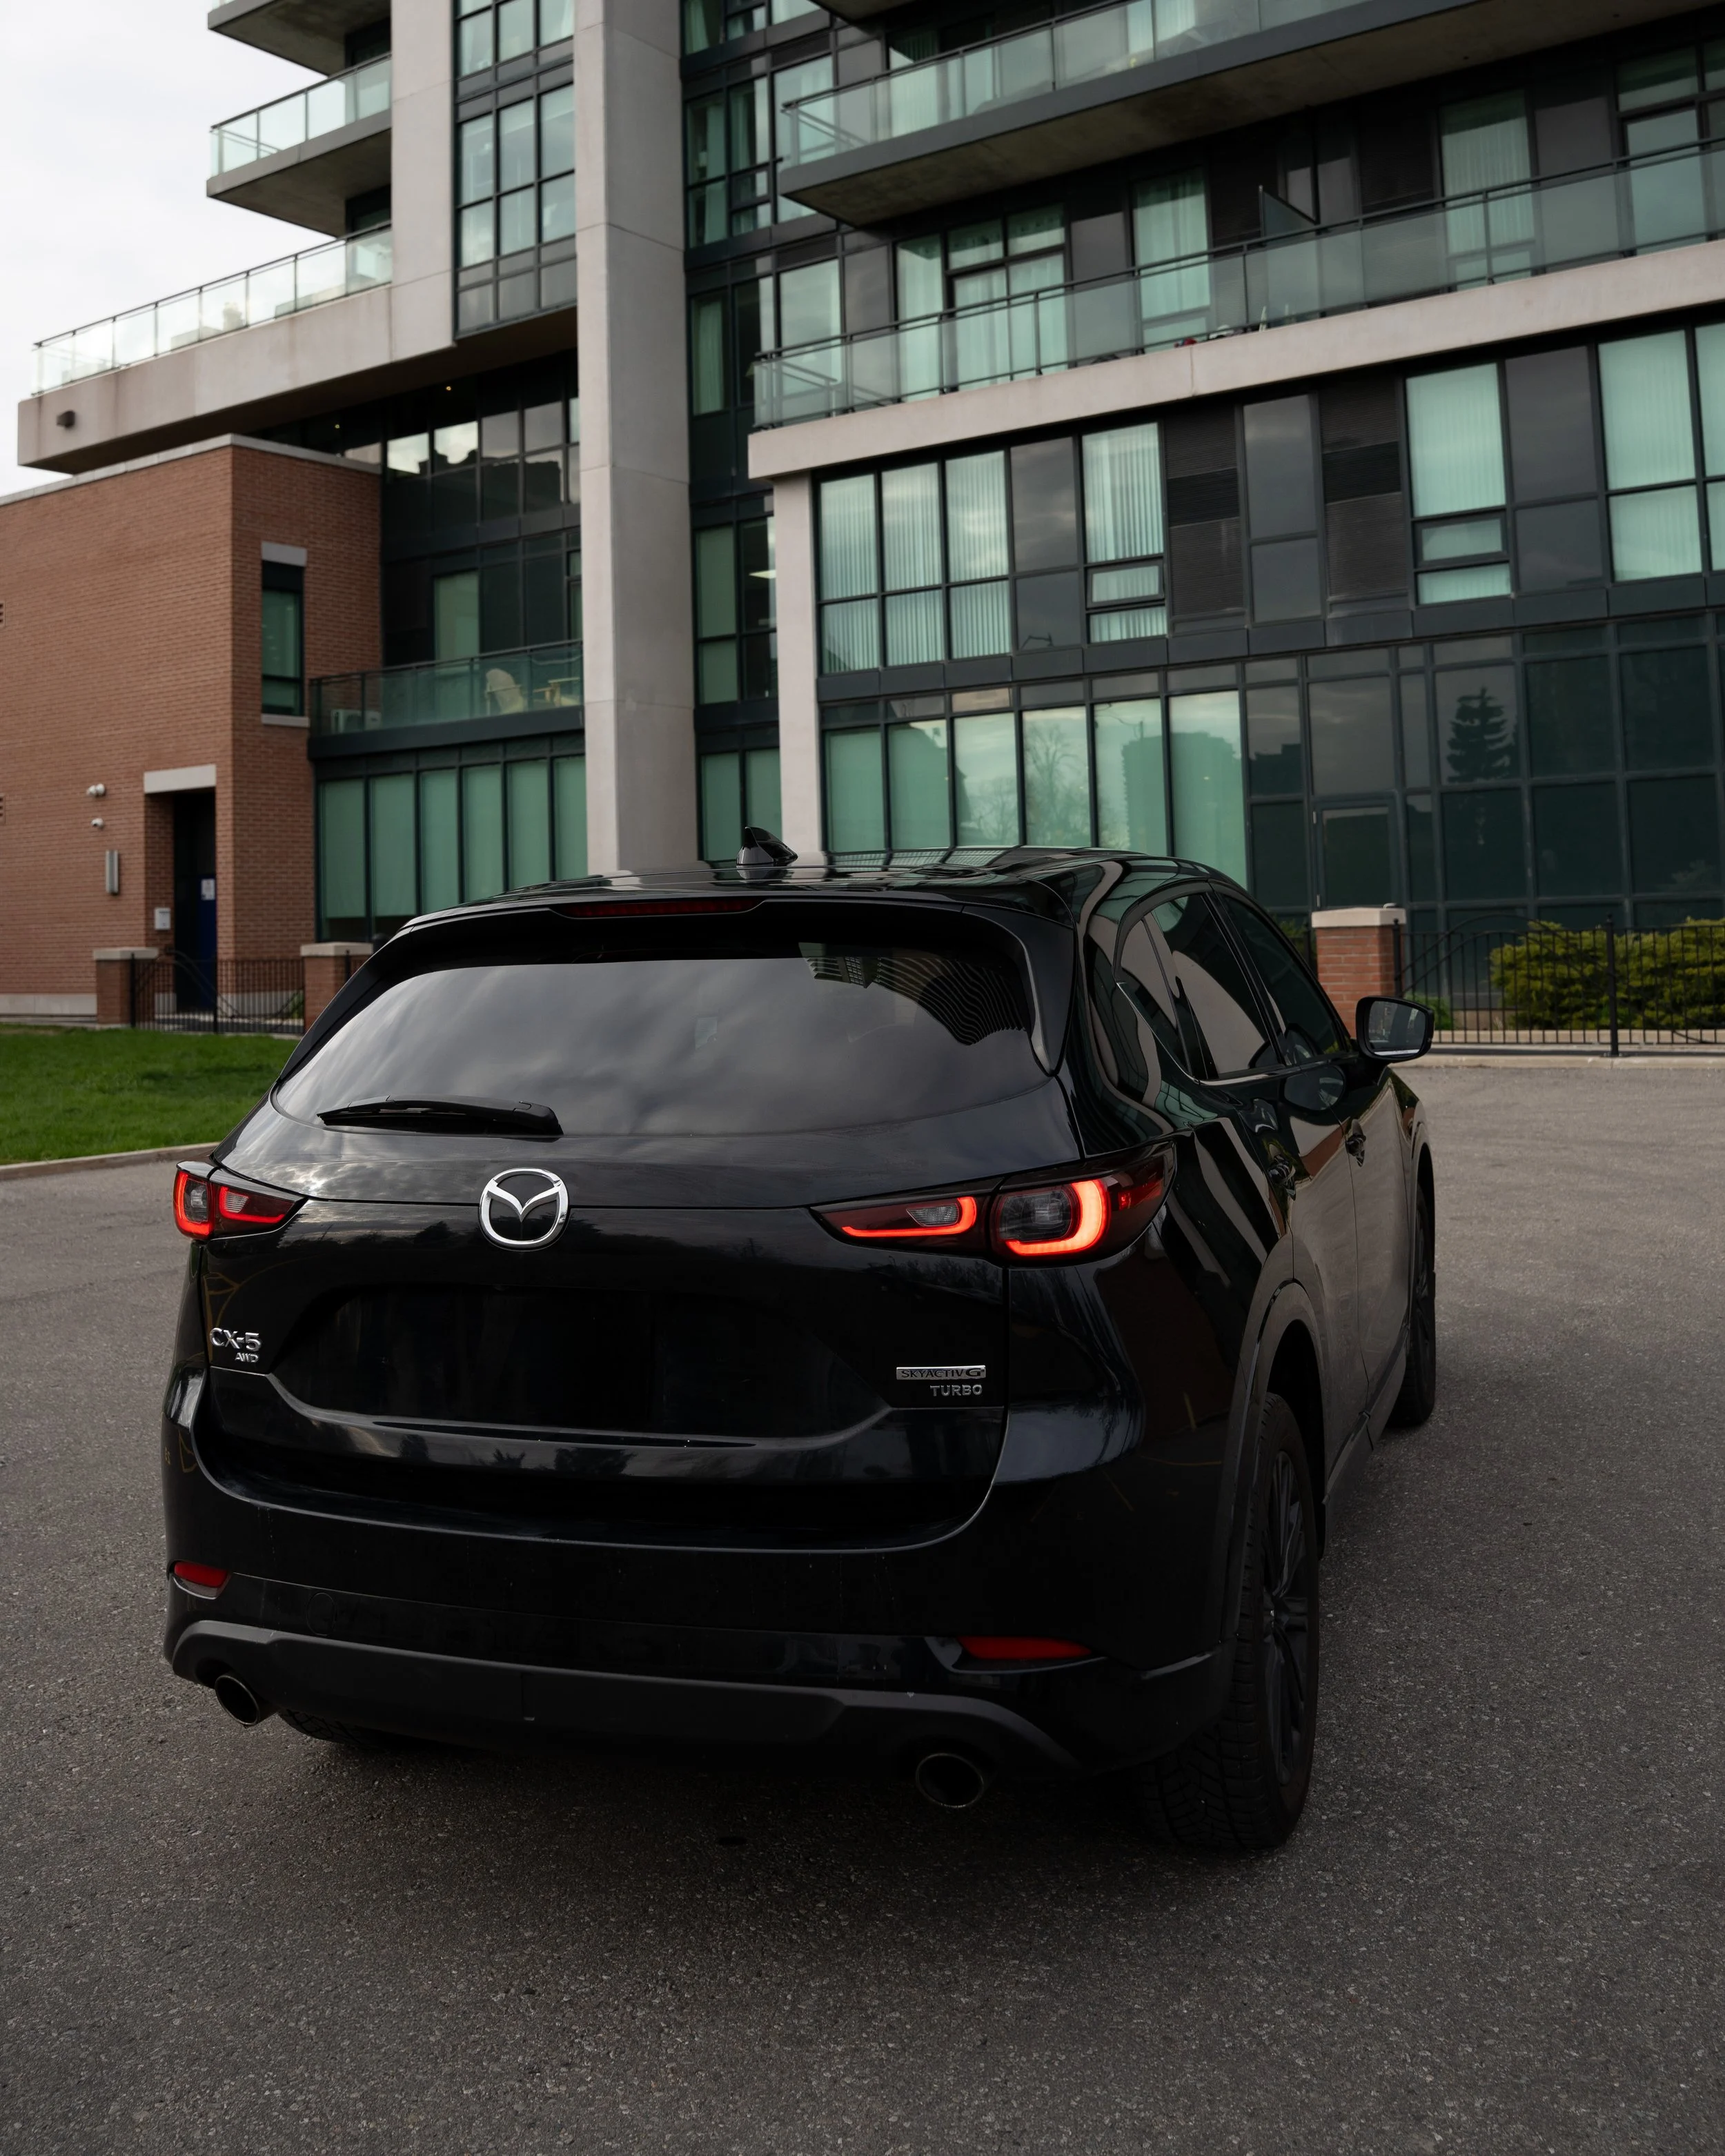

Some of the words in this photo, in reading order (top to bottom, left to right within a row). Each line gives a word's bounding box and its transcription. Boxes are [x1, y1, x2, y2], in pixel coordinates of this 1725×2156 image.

[210, 1327, 262, 1352] CX-5
[235, 1352, 259, 1363] AWD
[930, 1384, 983, 1396] TURBO
